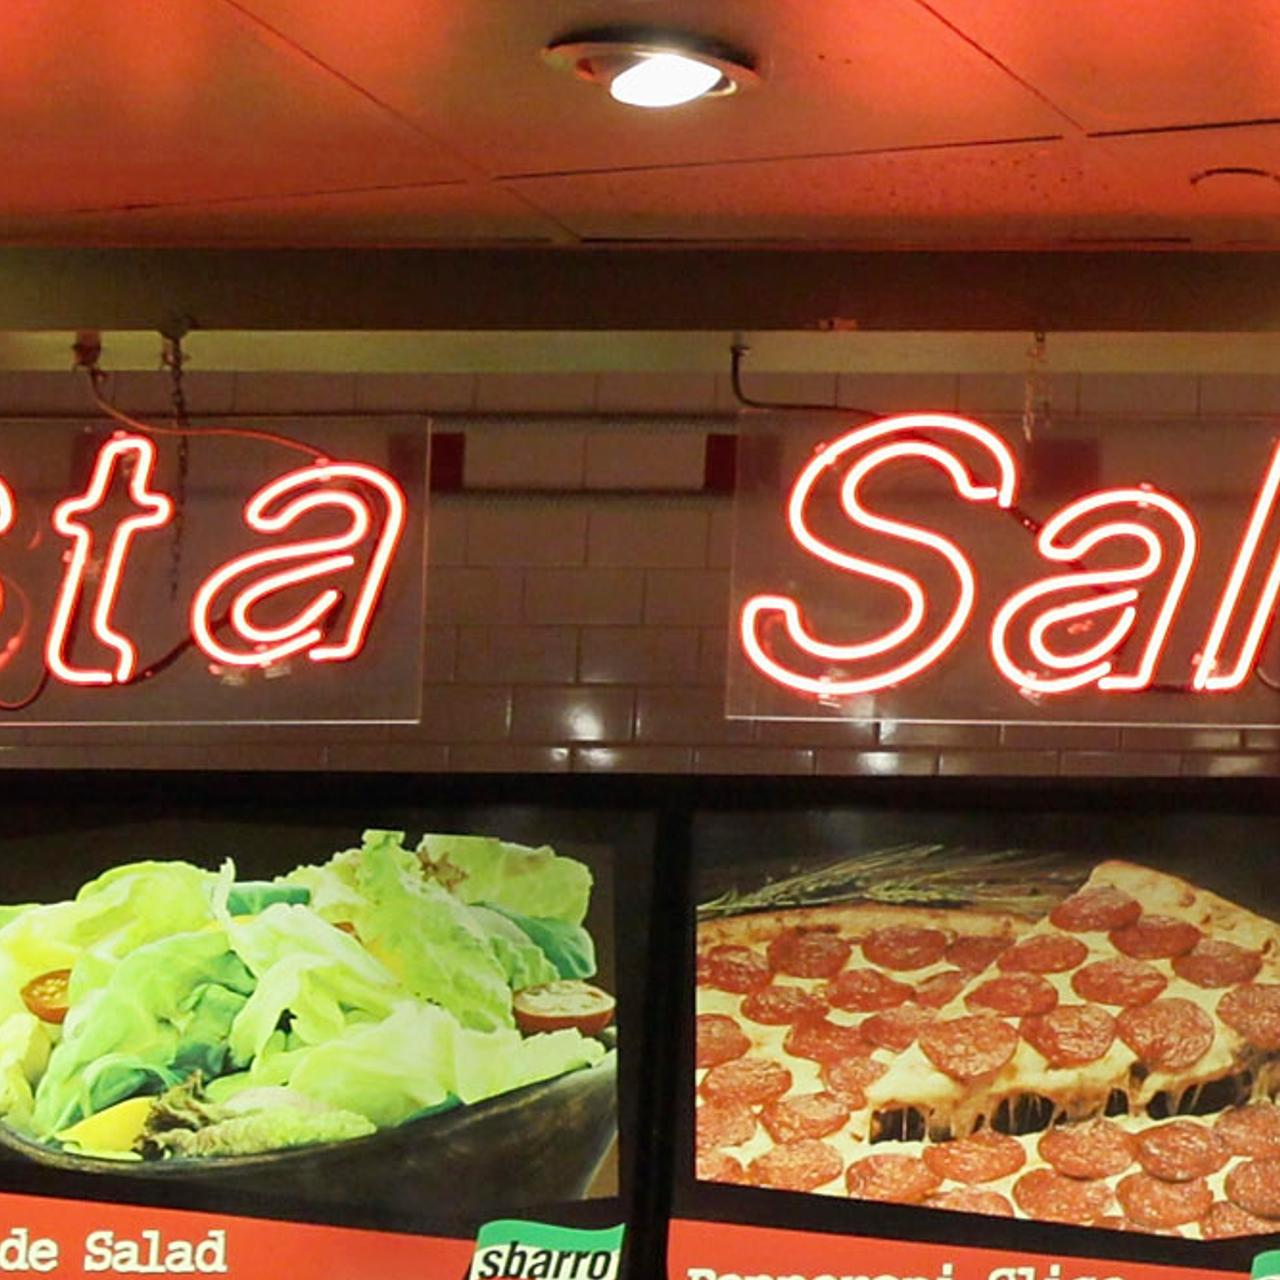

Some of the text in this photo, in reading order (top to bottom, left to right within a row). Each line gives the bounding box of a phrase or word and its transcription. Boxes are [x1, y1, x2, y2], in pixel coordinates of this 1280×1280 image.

[0, 434, 406, 688] ta
[0, 1227, 229, 1274] de Salad
[478, 1240, 612, 1280] sbarro
